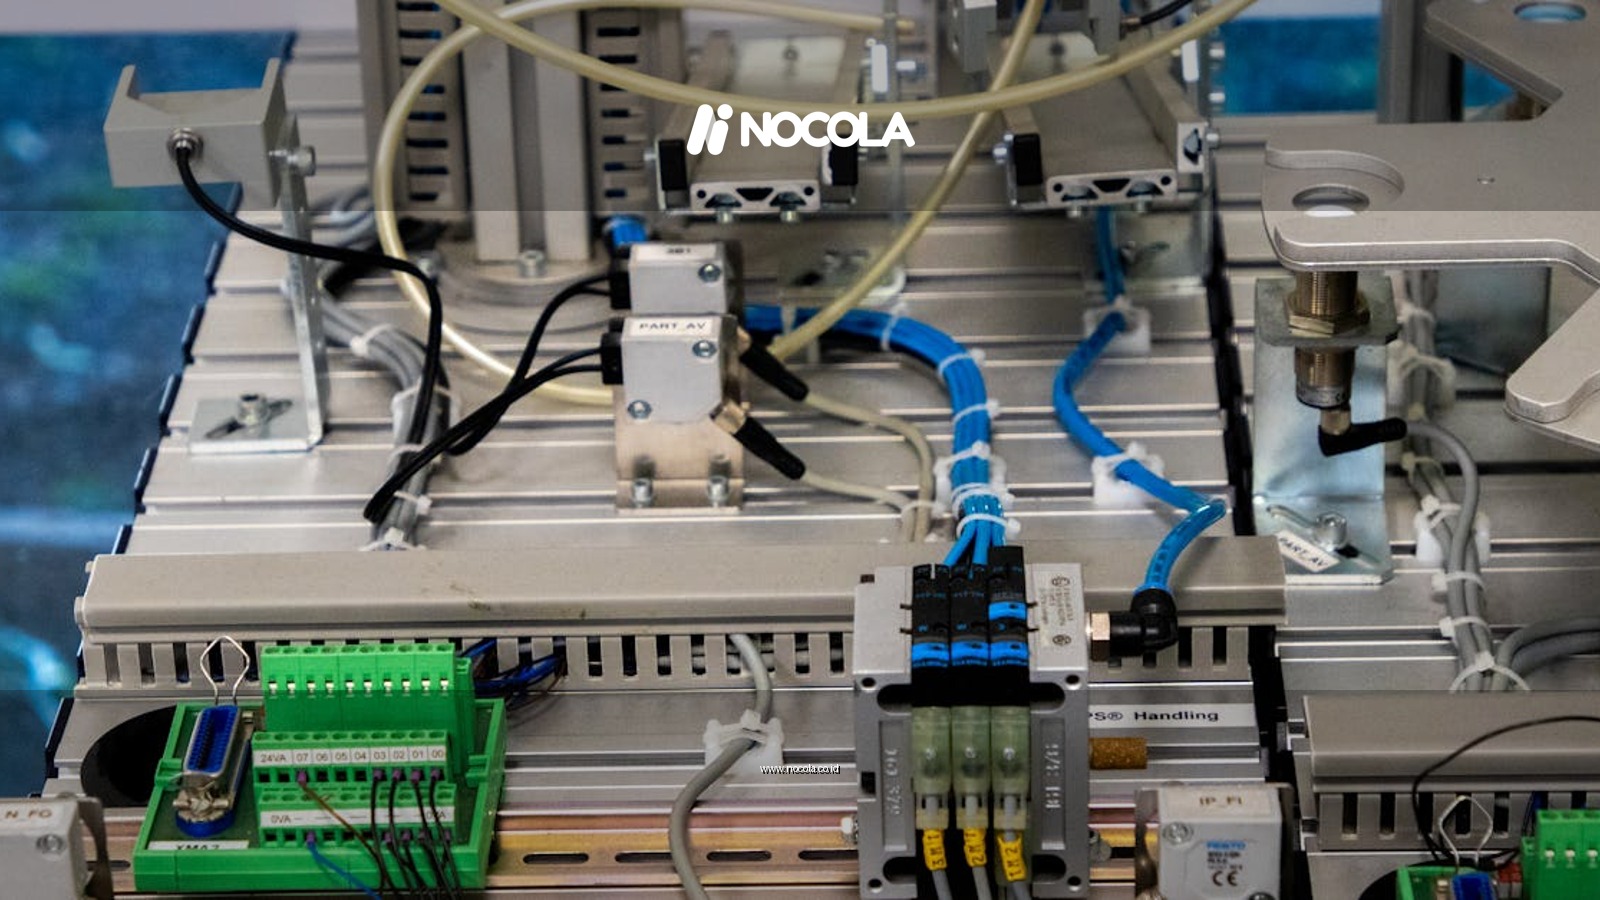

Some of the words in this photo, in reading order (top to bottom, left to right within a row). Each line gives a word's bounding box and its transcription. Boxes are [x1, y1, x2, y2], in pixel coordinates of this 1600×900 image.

[1134, 711, 1219, 722] Handling
[260, 752, 287, 763] 24VA
[296, 752, 309, 761] 07
[354, 751, 366, 760] 04
[373, 751, 387, 760] 03
[393, 750, 405, 759] 02
[412, 750, 424, 759] 01
[432, 749, 444, 758] 00
